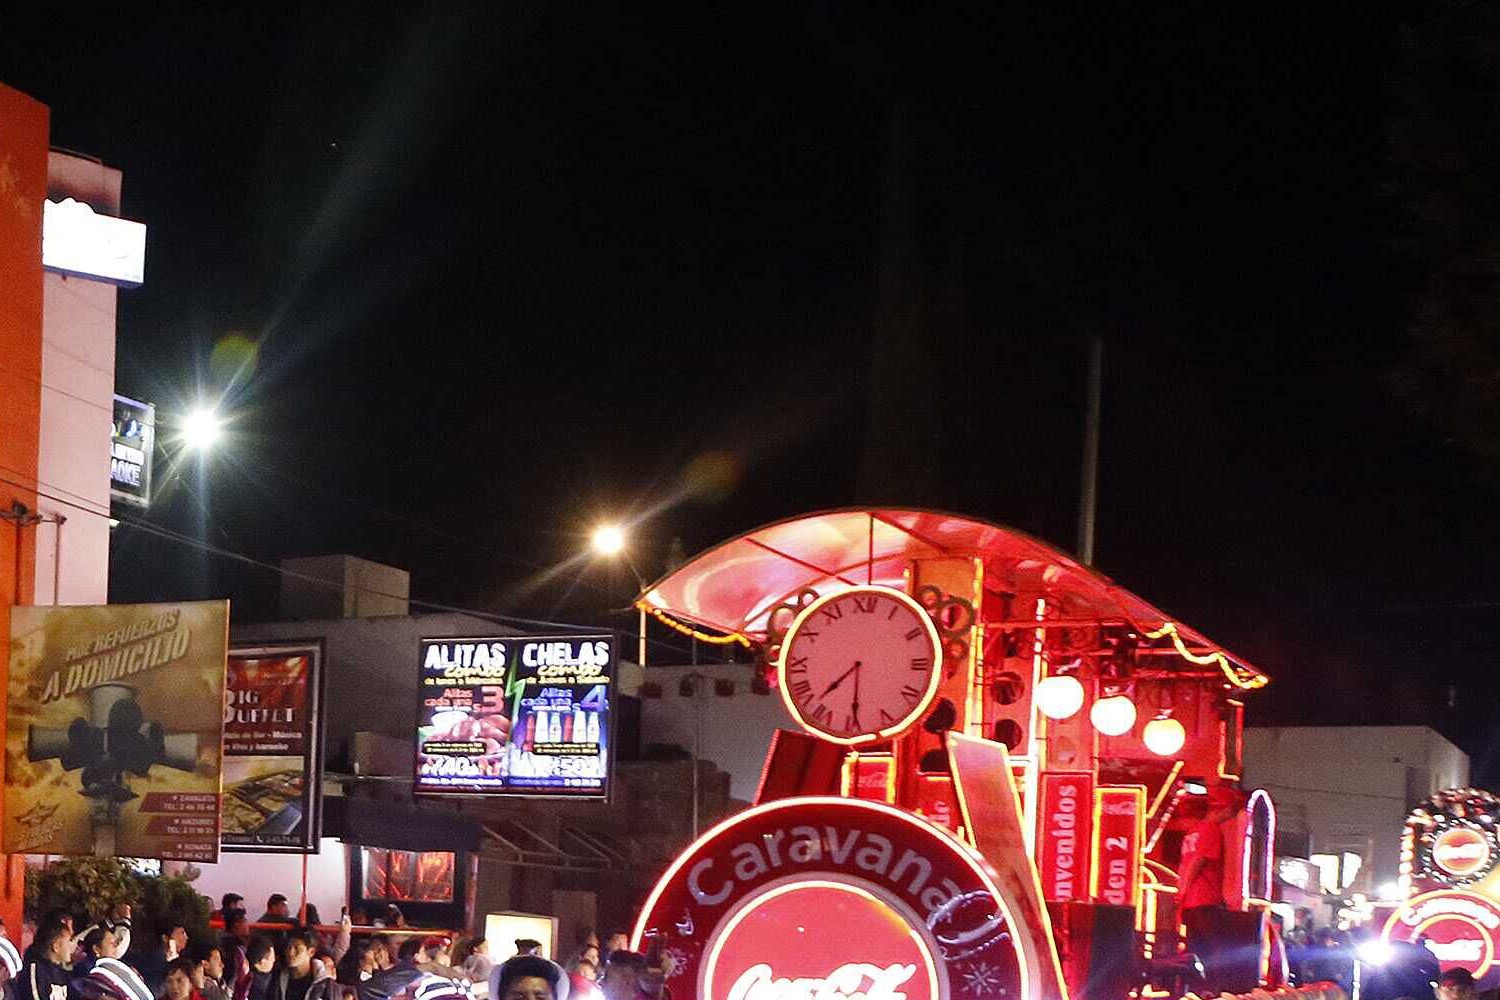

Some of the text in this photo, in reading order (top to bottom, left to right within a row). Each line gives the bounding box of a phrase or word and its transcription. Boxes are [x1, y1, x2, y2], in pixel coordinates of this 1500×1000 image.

[63, 627, 193, 696] DOMICILIO
[423, 641, 610, 669] ALITAS CHELAS
[686, 825, 963, 907] Caravana
[1051, 784, 1078, 903] nvenidos
